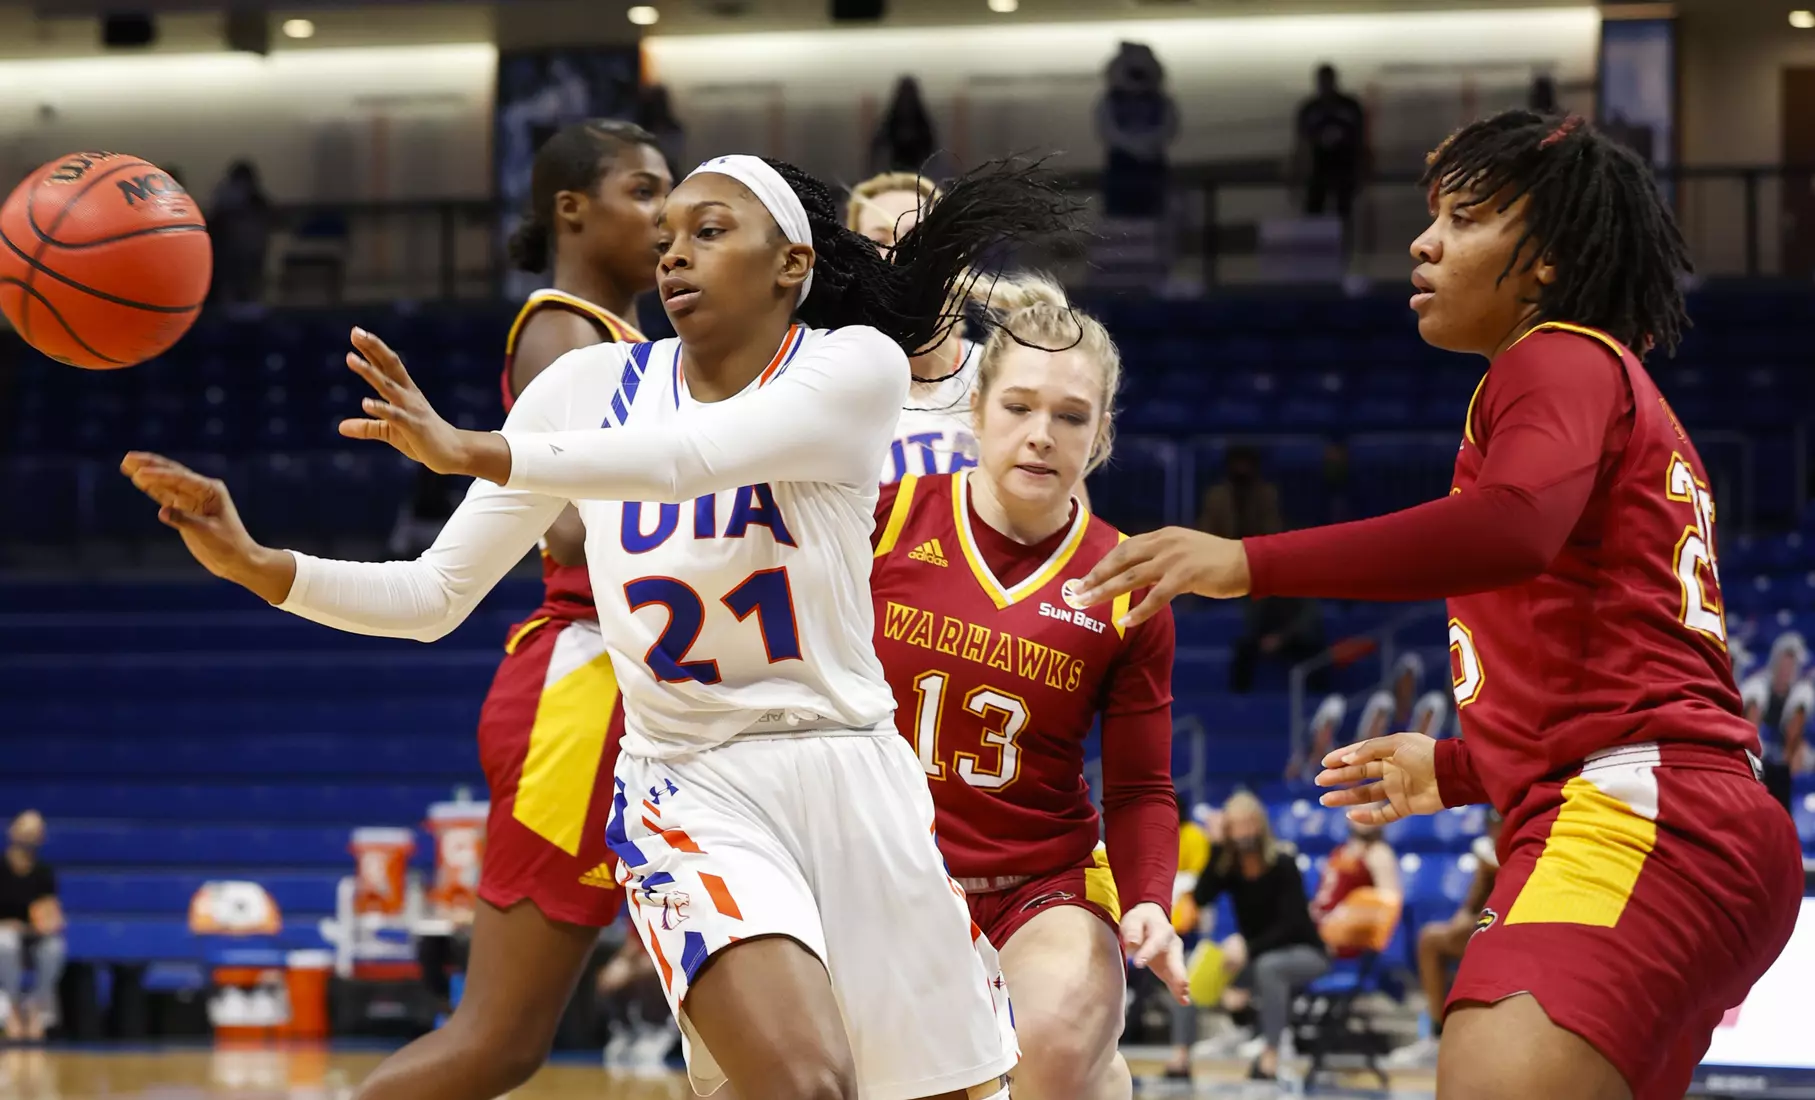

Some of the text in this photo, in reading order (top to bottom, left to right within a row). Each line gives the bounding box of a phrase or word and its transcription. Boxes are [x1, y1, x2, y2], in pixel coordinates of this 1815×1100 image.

[908, 551, 949, 568] adidas
[623, 566, 804, 685] 21
[884, 601, 1085, 693] WARHAWKS
[913, 669, 1031, 793] 13
